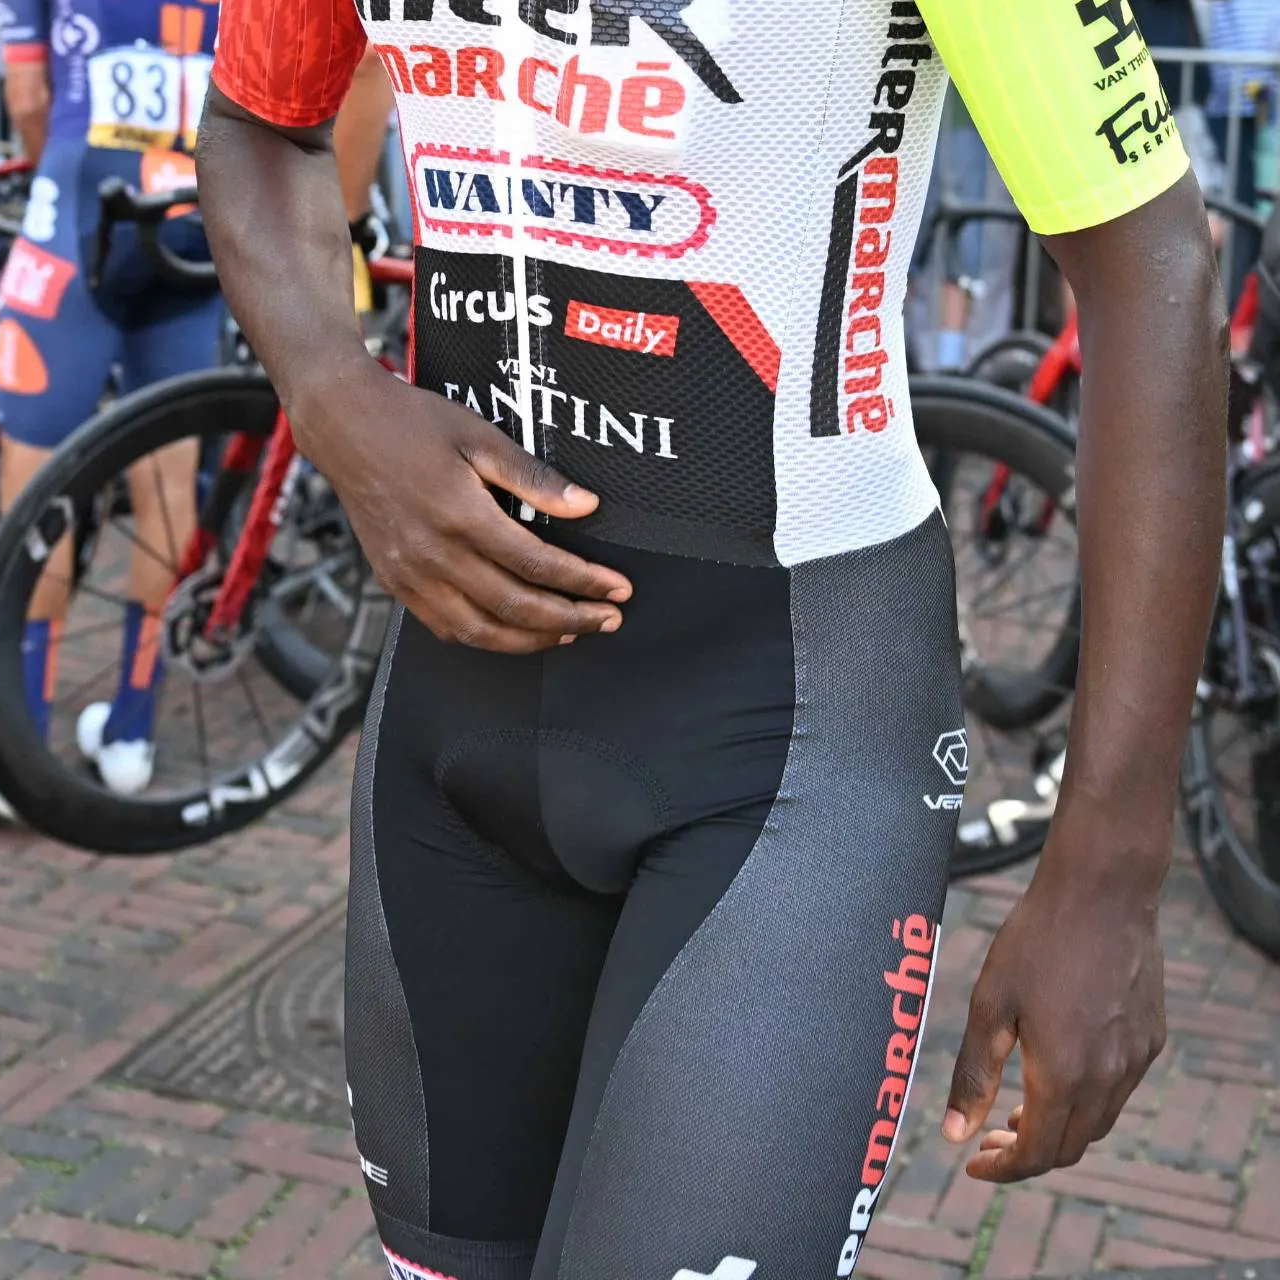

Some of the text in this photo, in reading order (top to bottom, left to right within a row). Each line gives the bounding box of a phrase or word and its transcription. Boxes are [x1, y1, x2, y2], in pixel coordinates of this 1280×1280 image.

[111, 61, 167, 122] 83
[1093, 46, 1150, 92] VAN THU
[423, 166, 668, 233] WANTY
[430, 271, 669, 356] Circus Daily
[445, 379, 680, 460] FANTINI
